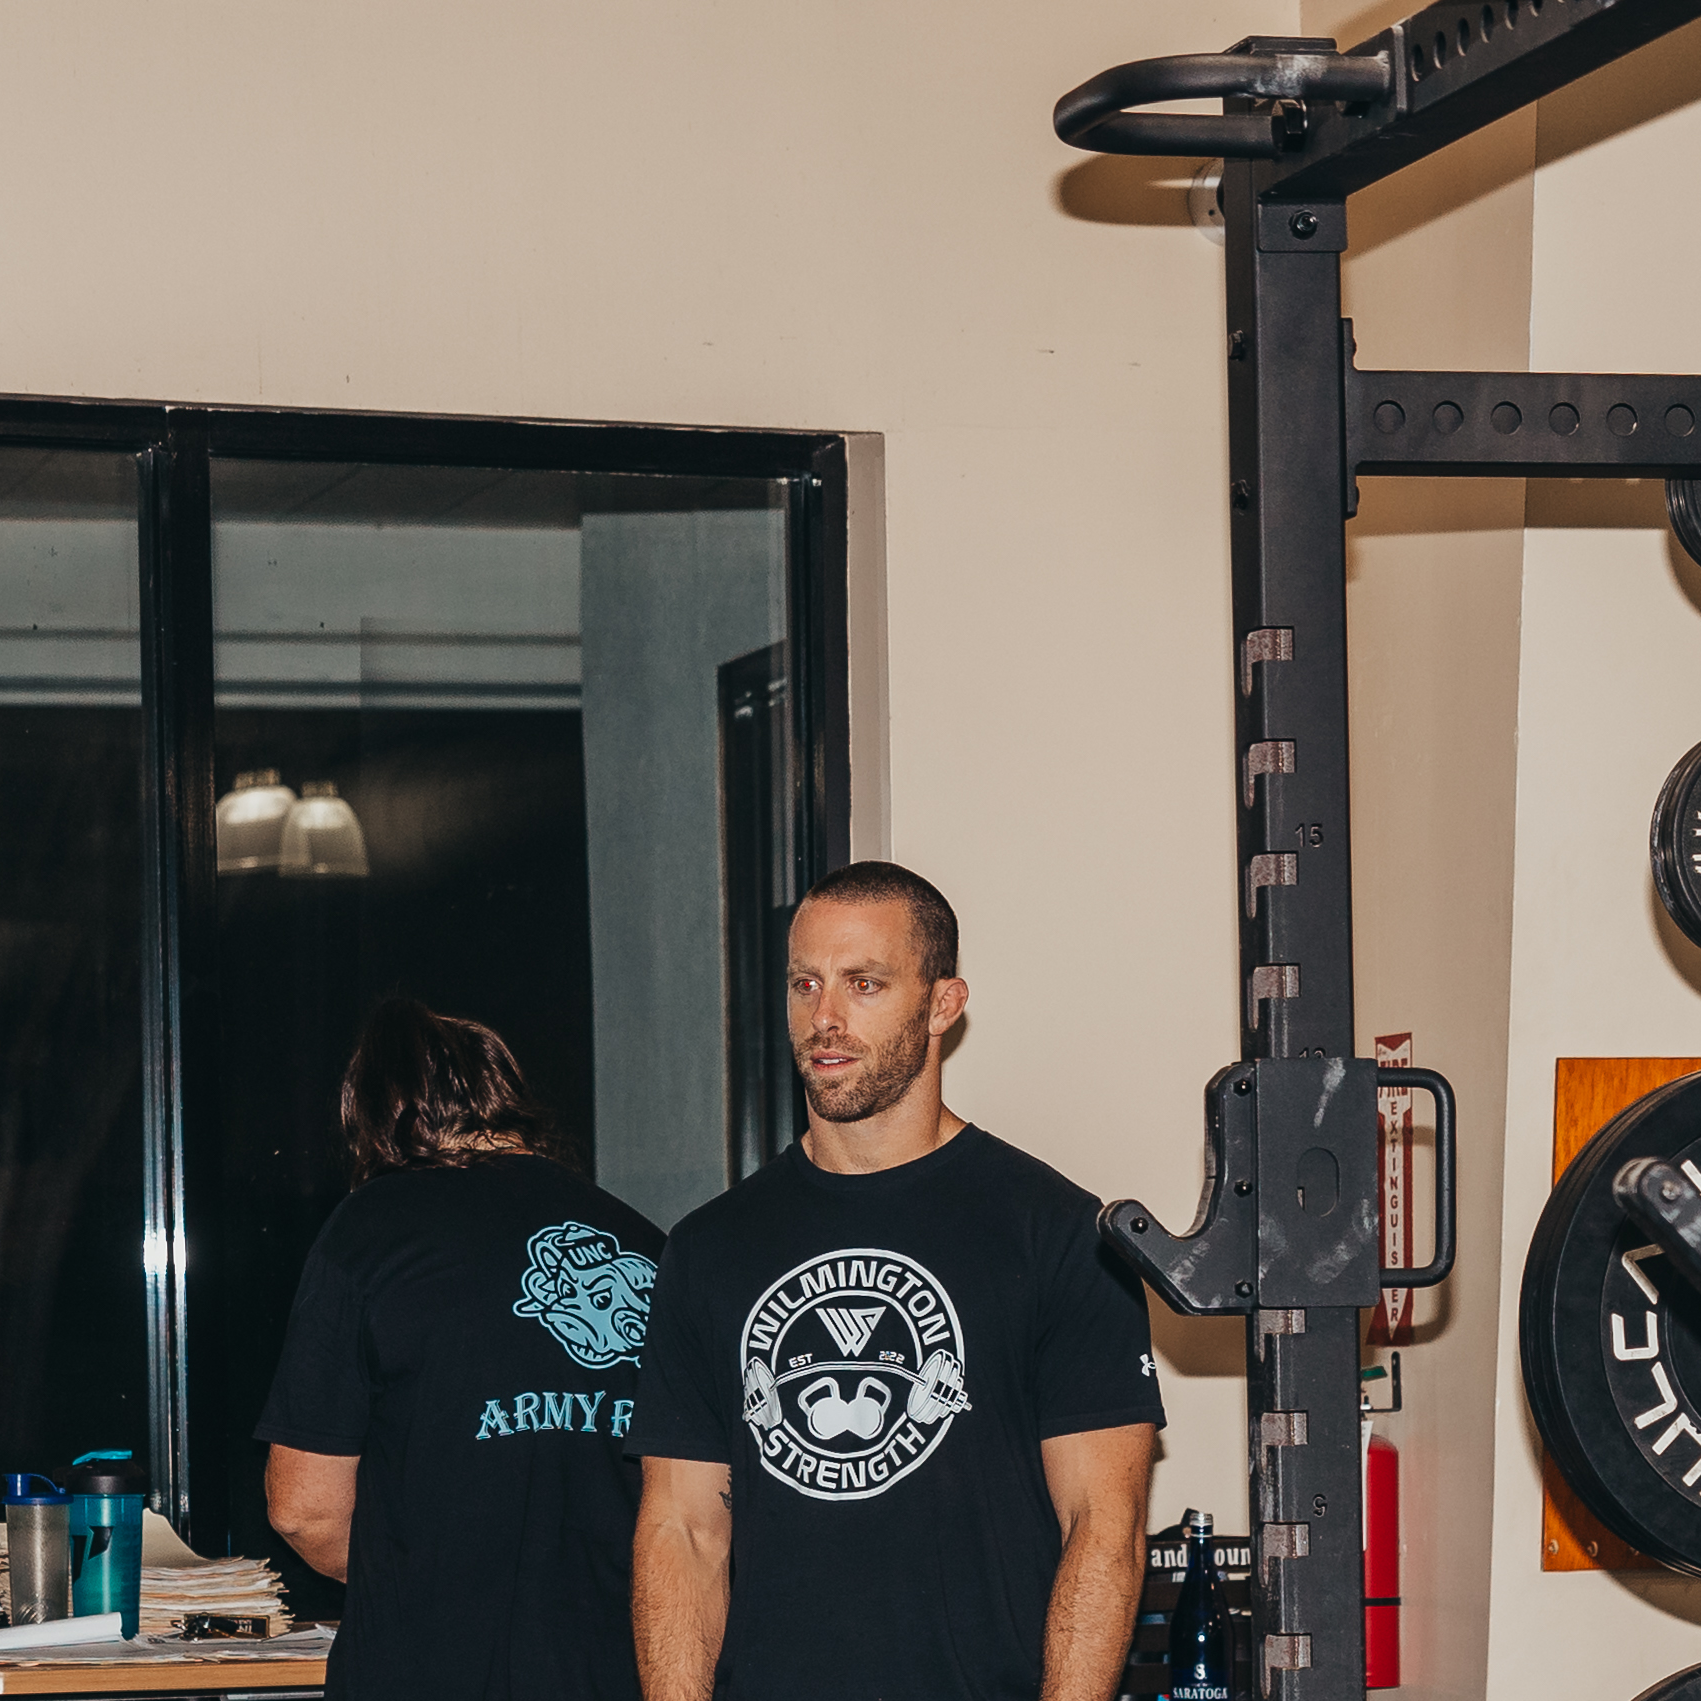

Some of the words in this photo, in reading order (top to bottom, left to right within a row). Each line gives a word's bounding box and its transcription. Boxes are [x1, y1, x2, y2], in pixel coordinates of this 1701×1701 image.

[1294, 823, 1325, 849] 15
[1389, 1101, 1400, 1323] EXTINGUISER
[568, 1241, 612, 1266] UNC
[749, 1260, 951, 1351] WILMINGTON
[788, 1353, 813, 1369] EST
[475, 1390, 607, 1441] ARMY
[764, 1421, 926, 1490] STRENGTH
[1150, 1543, 1188, 1568] and
[1214, 1547, 1251, 1567] oun
[1172, 1687, 1229, 1700] SARATOGA
